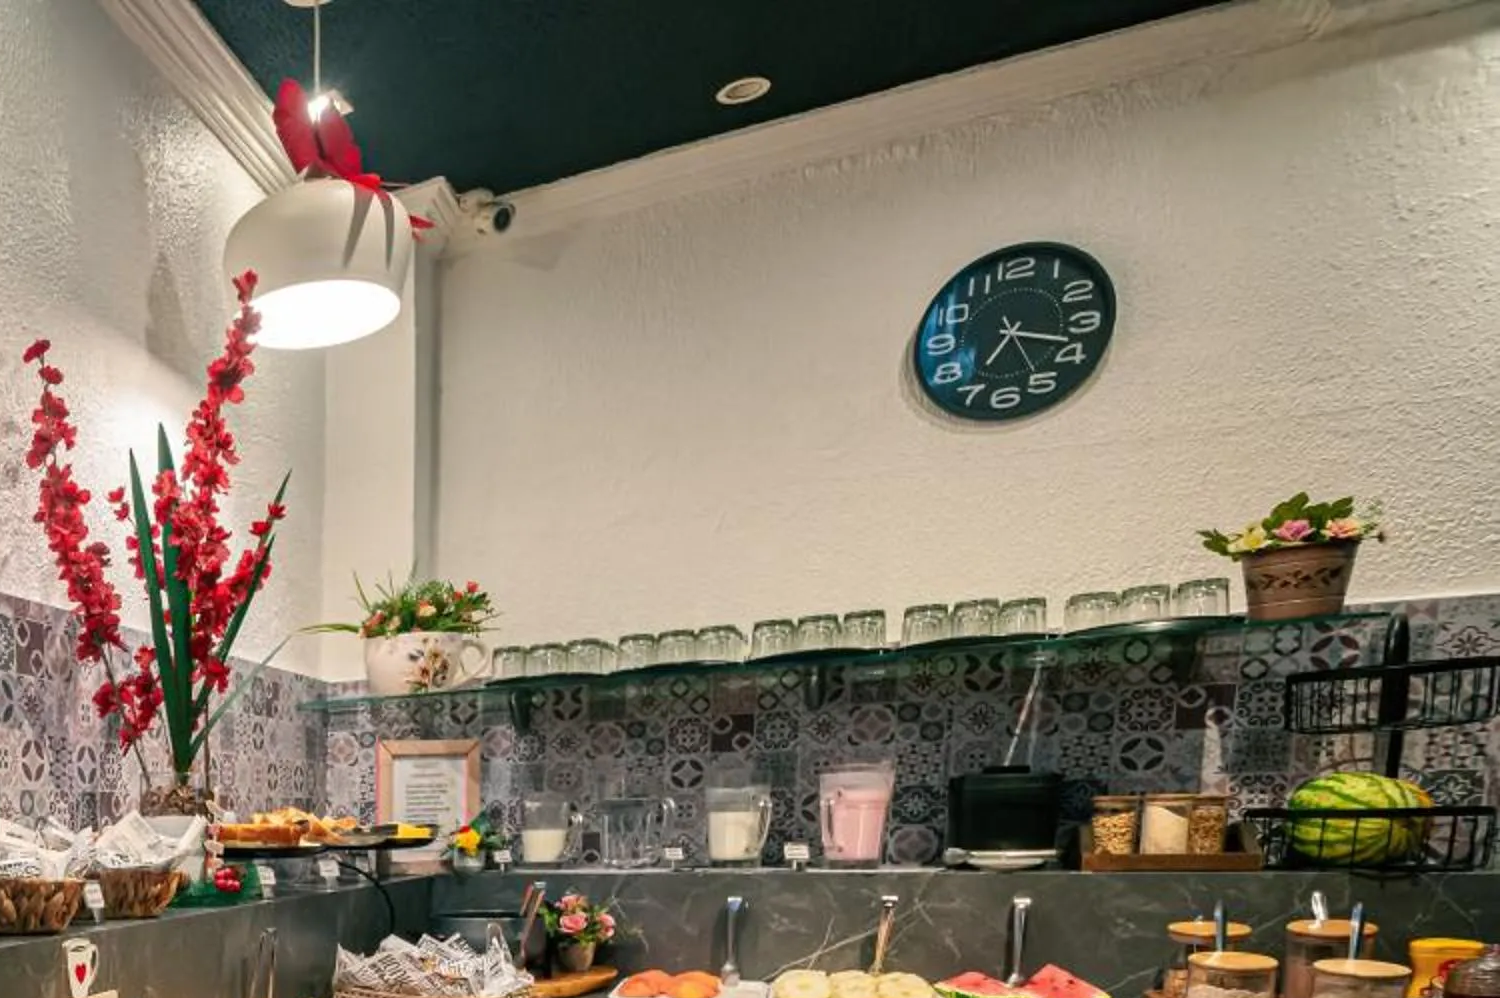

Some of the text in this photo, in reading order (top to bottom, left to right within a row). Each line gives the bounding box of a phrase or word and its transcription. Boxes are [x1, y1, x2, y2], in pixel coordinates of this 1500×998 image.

[997, 257, 1036, 281] 12
[1053, 258, 1061, 279] 1
[968, 273, 991, 297] 11
[1062, 279, 1094, 303] 2
[938, 303, 969, 327] 10
[1068, 311, 1101, 334] 3
[926, 333, 956, 355] 9
[1054, 342, 1086, 364] 4
[933, 362, 963, 384] 8
[1027, 371, 1058, 394] 5
[956, 383, 986, 406] 7
[989, 387, 1021, 409] 6
